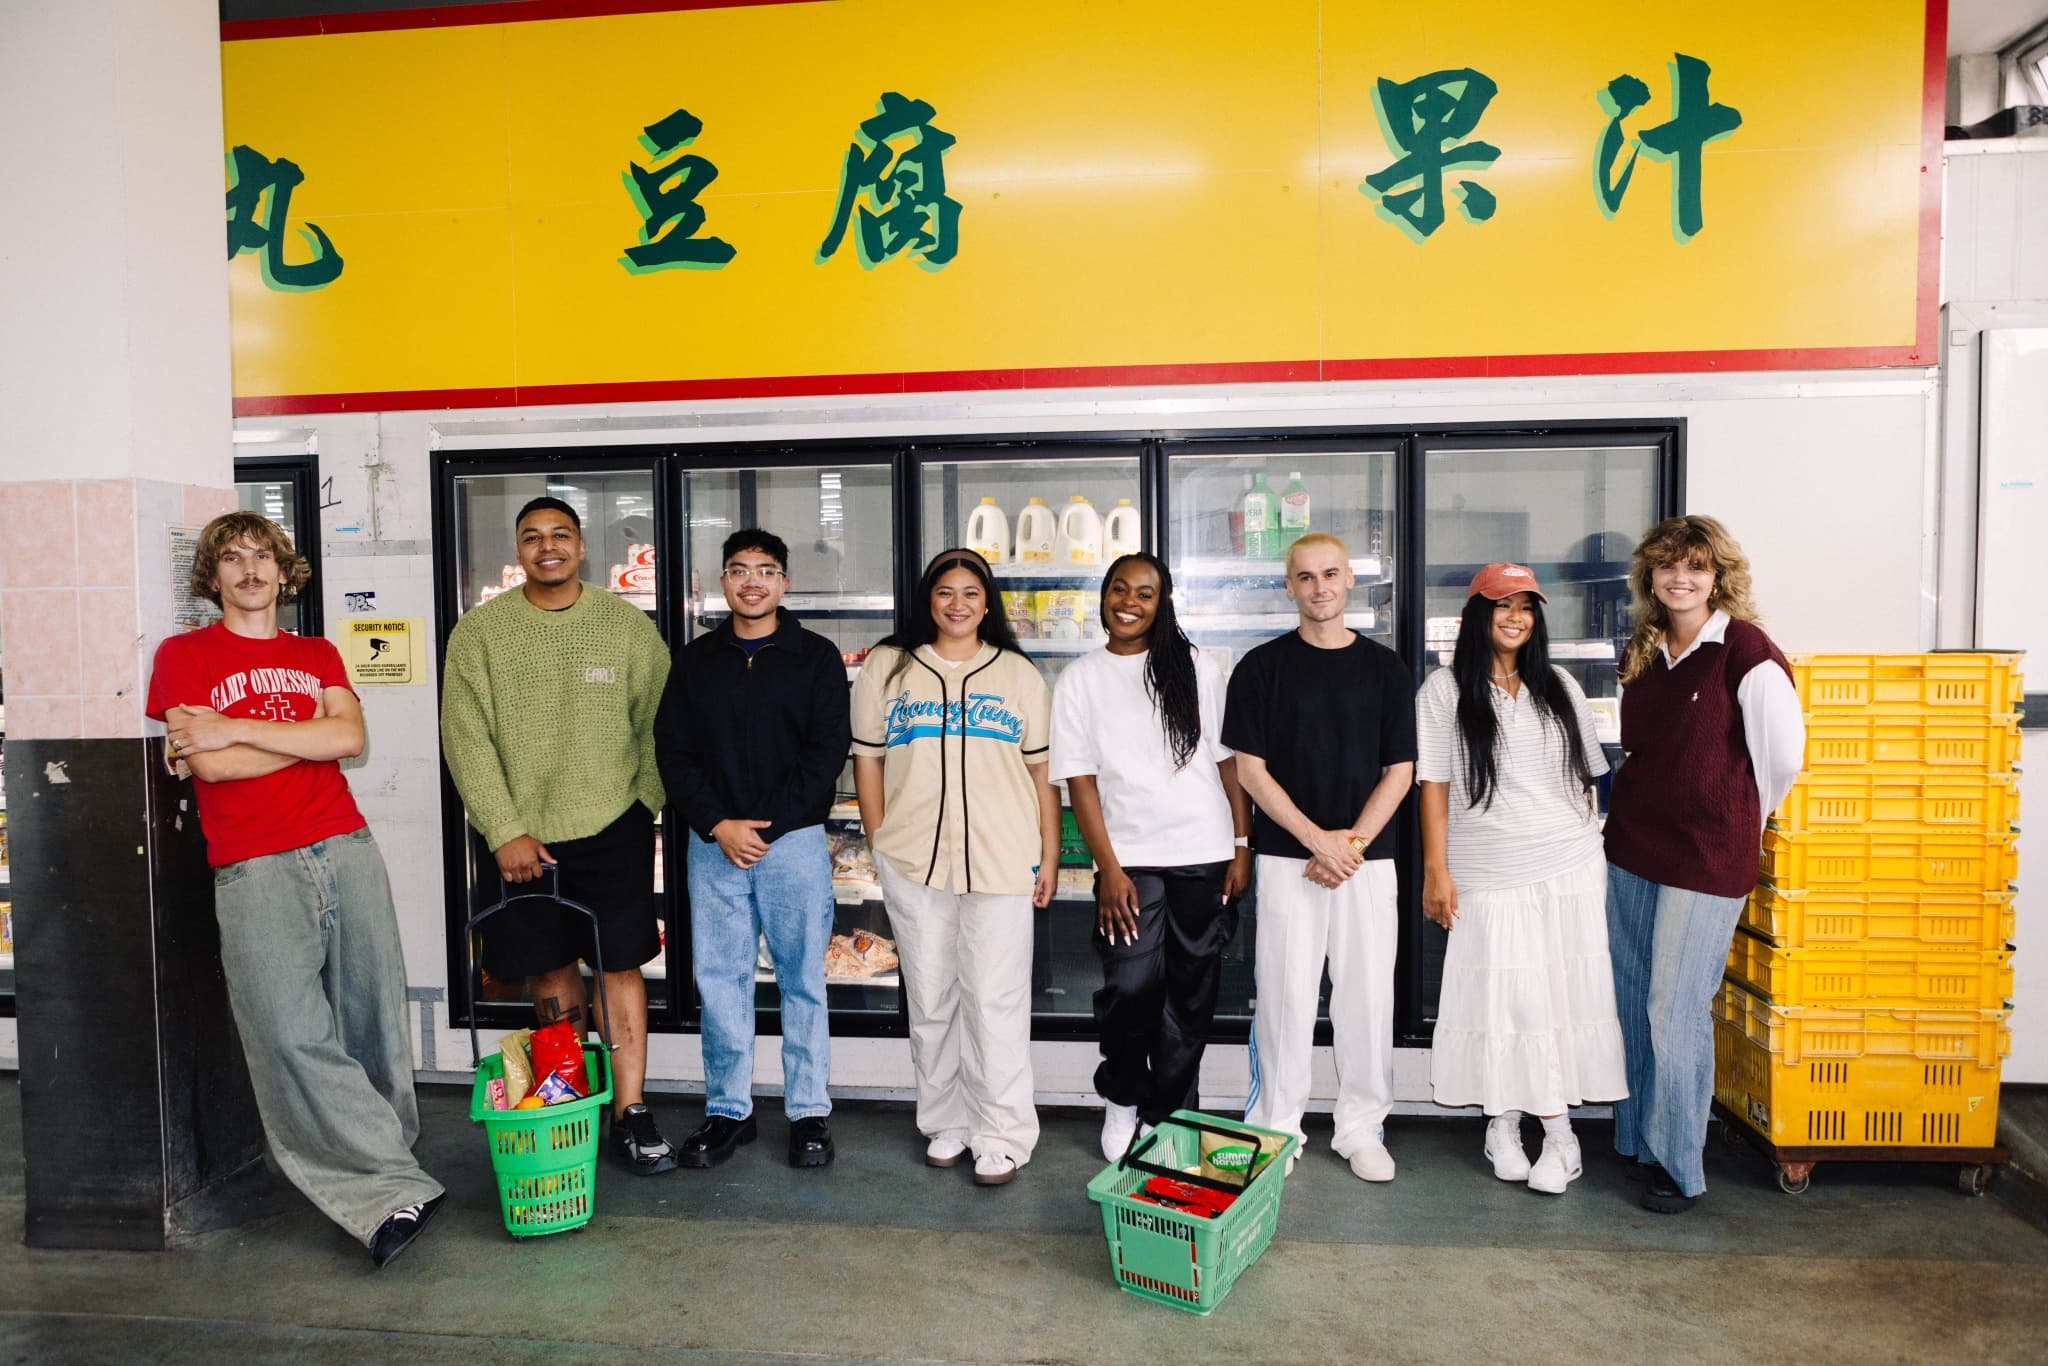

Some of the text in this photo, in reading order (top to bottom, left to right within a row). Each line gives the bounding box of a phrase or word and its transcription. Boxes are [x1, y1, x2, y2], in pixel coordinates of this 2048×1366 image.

[620, 93, 962, 274] 豆腐
[1360, 54, 1741, 243] 果汁
[320, 475, 342, 509] 1
[354, 623, 405, 632] SECURITY NOTICE
[211, 667, 321, 712] CAMP ONDESSON
[1216, 1152, 1255, 1161] summe
